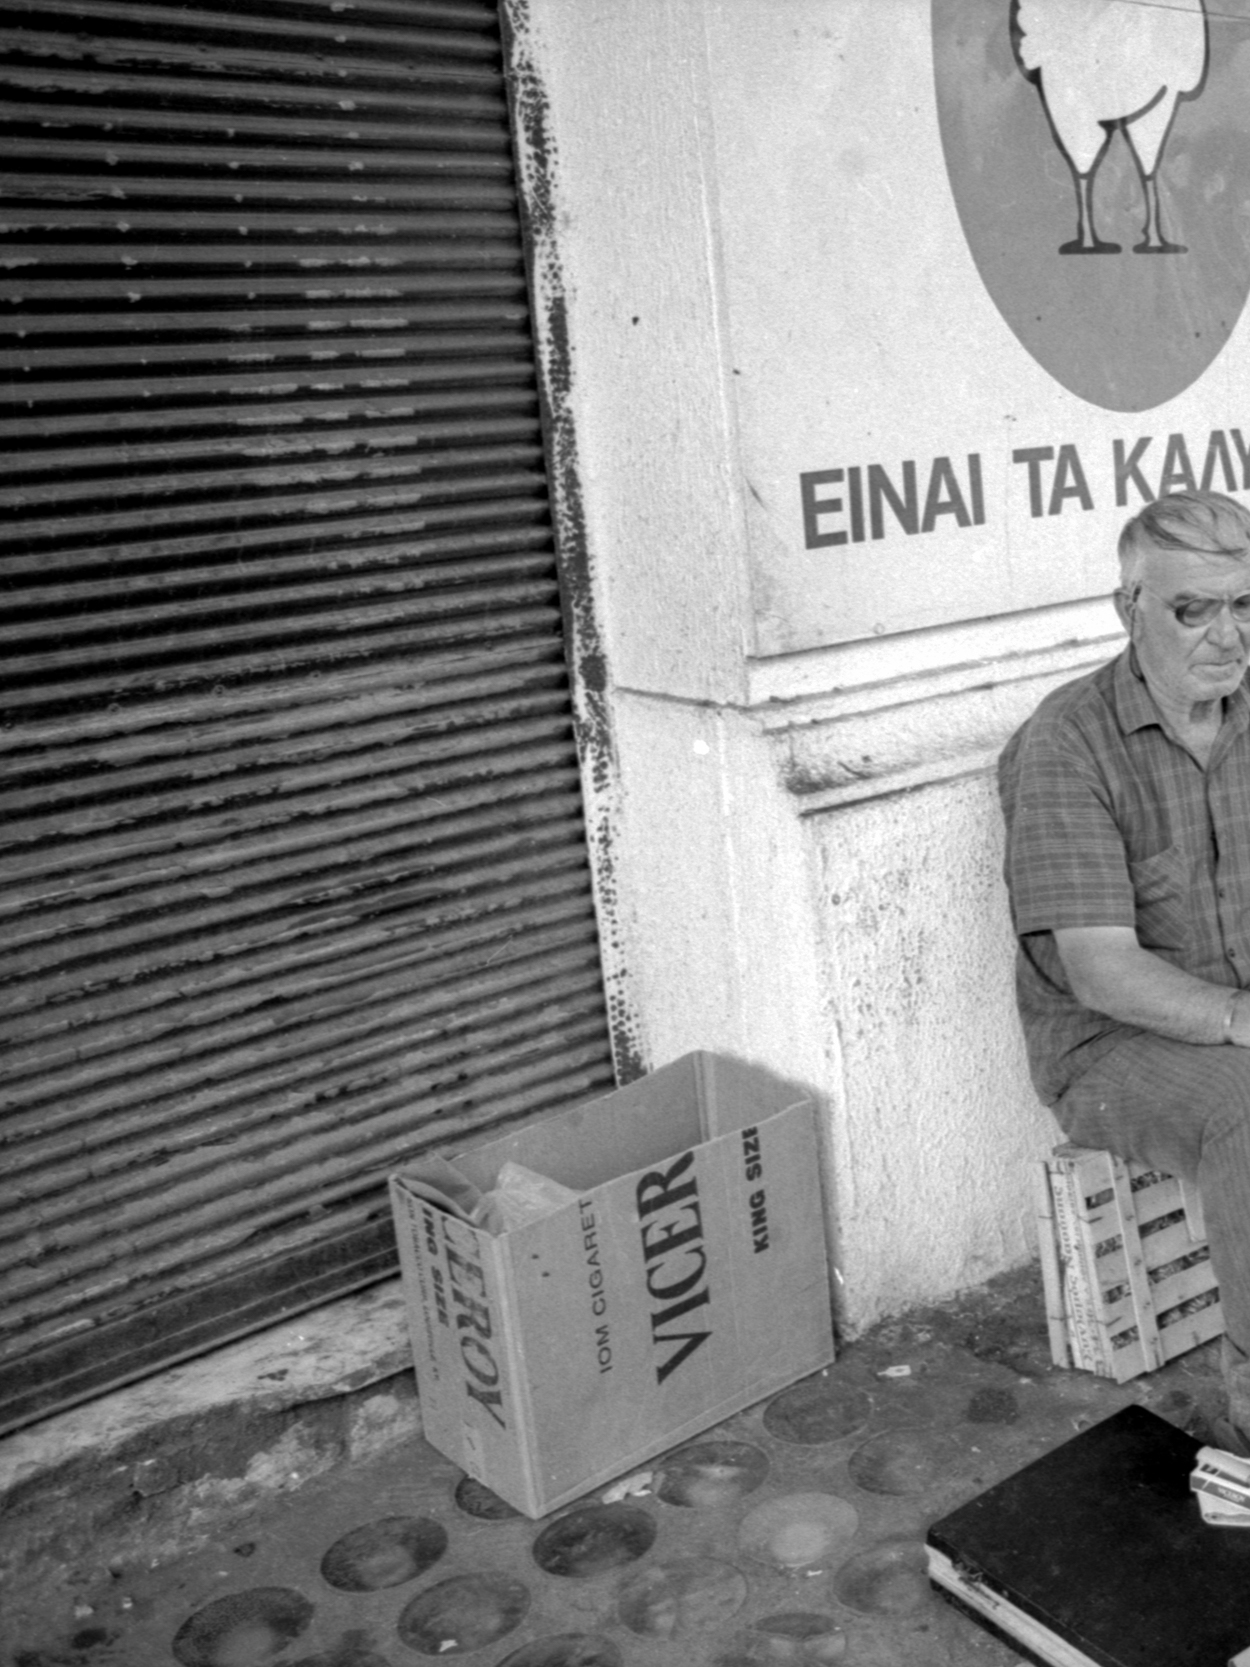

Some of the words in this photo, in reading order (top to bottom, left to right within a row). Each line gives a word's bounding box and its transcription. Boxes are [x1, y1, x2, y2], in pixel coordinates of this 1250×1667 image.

[800, 453, 985, 550] ΕΙΝΑΙ
[1012, 443, 1095, 518] ΤΑ
[742, 1126, 762, 1181] SIZE
[579, 1199, 607, 1317] CIGARET
[749, 1189, 769, 1254] KING
[431, 1266, 450, 1329] SIZE
[636, 1150, 714, 1386] VICER
